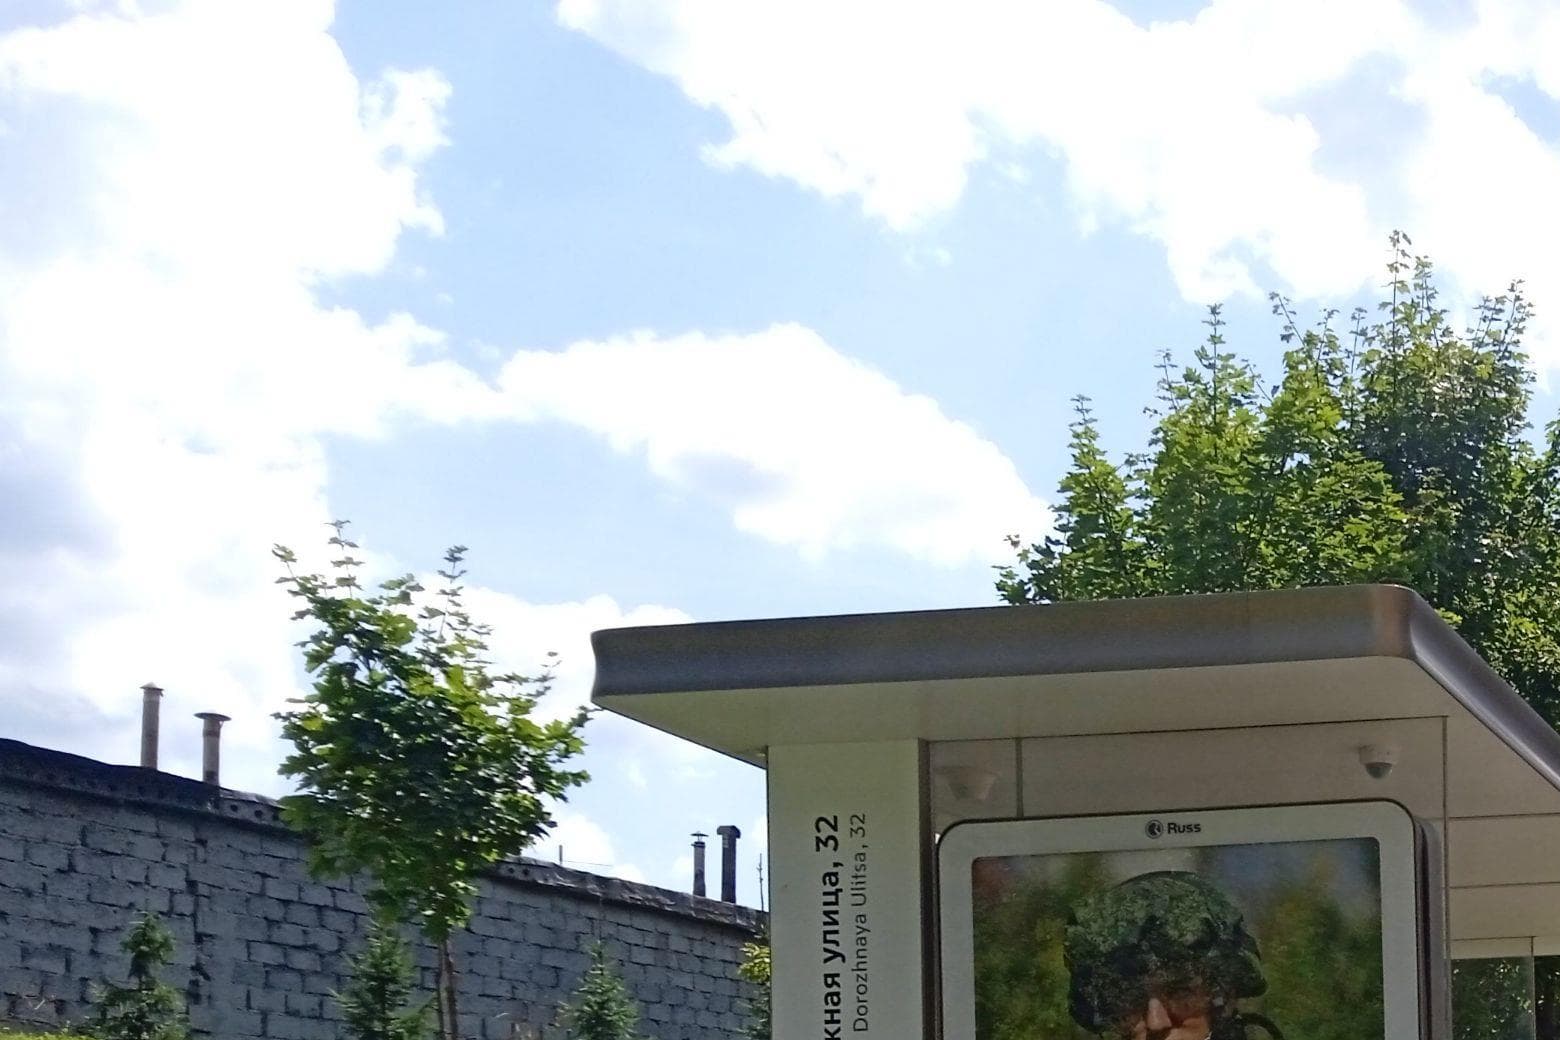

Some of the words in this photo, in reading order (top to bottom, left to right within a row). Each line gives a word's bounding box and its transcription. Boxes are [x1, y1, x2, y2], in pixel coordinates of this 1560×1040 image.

[814, 815, 839, 852] 32
[850, 813, 866, 838] 32
[1167, 822, 1202, 835] Russ
[851, 844, 869, 907] Ulitsa,
[822, 861, 846, 964] улица,
[851, 913, 871, 1032] Dorozhnaya
